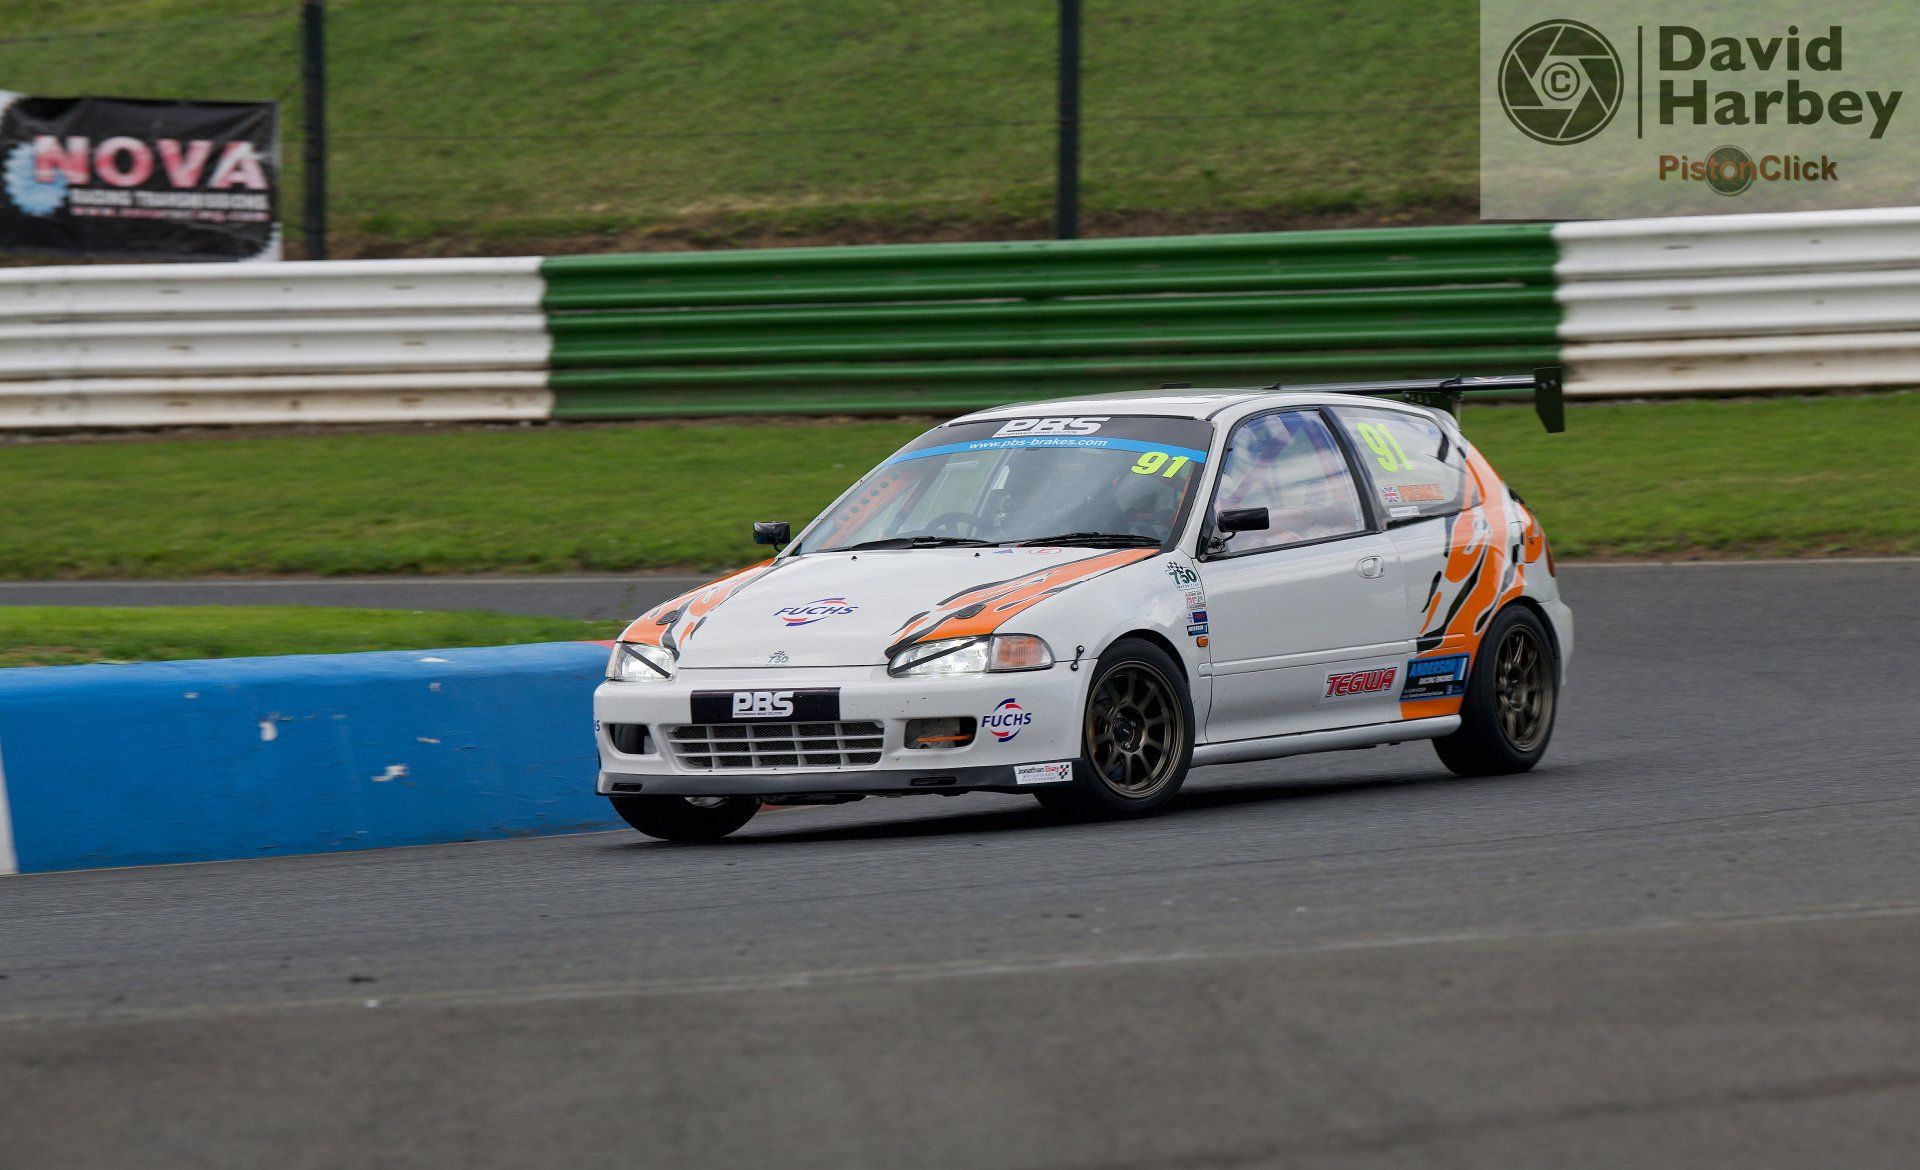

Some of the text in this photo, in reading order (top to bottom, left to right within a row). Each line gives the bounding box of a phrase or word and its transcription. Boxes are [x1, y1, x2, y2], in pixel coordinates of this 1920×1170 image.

[33, 135, 268, 189] NOVA
[992, 416, 1112, 438] PBS
[969, 438, 1109, 450] www.pbs-brakes.com
[1356, 422, 1413, 473] 91
[1131, 451, 1190, 478] 91
[1169, 568, 1197, 586] 750
[773, 606, 859, 617] FUCHS
[1326, 666, 1397, 699] TEGIWA
[732, 691, 795, 719] PBS
[981, 712, 1032, 728] FUCHS
